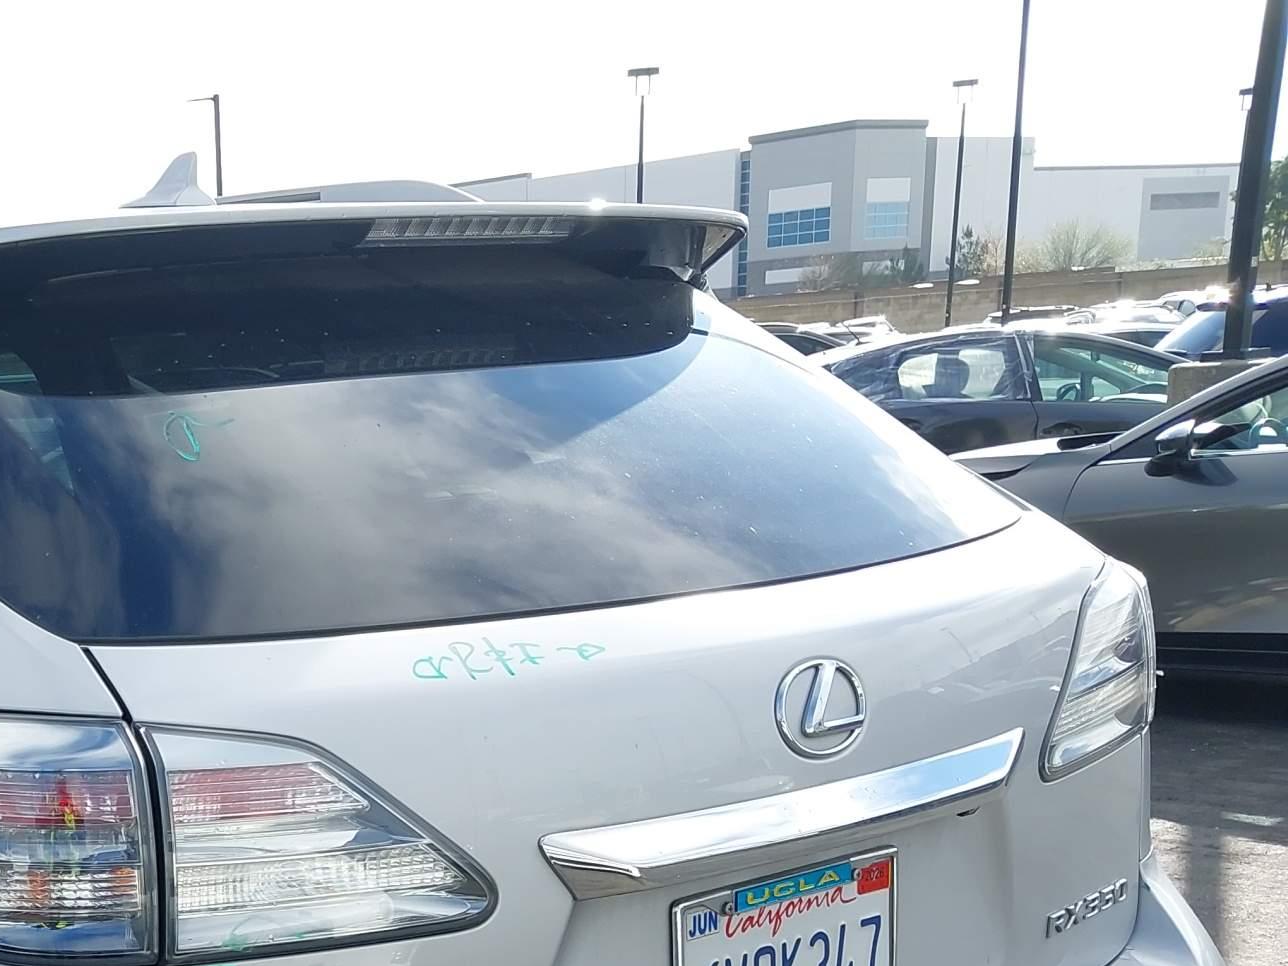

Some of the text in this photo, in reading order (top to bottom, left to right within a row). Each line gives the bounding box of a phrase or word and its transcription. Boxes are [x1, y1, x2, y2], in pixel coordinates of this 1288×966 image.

[746, 869, 840, 905] UCLA
[688, 910, 718, 938] JUN
[725, 885, 856, 938] California
